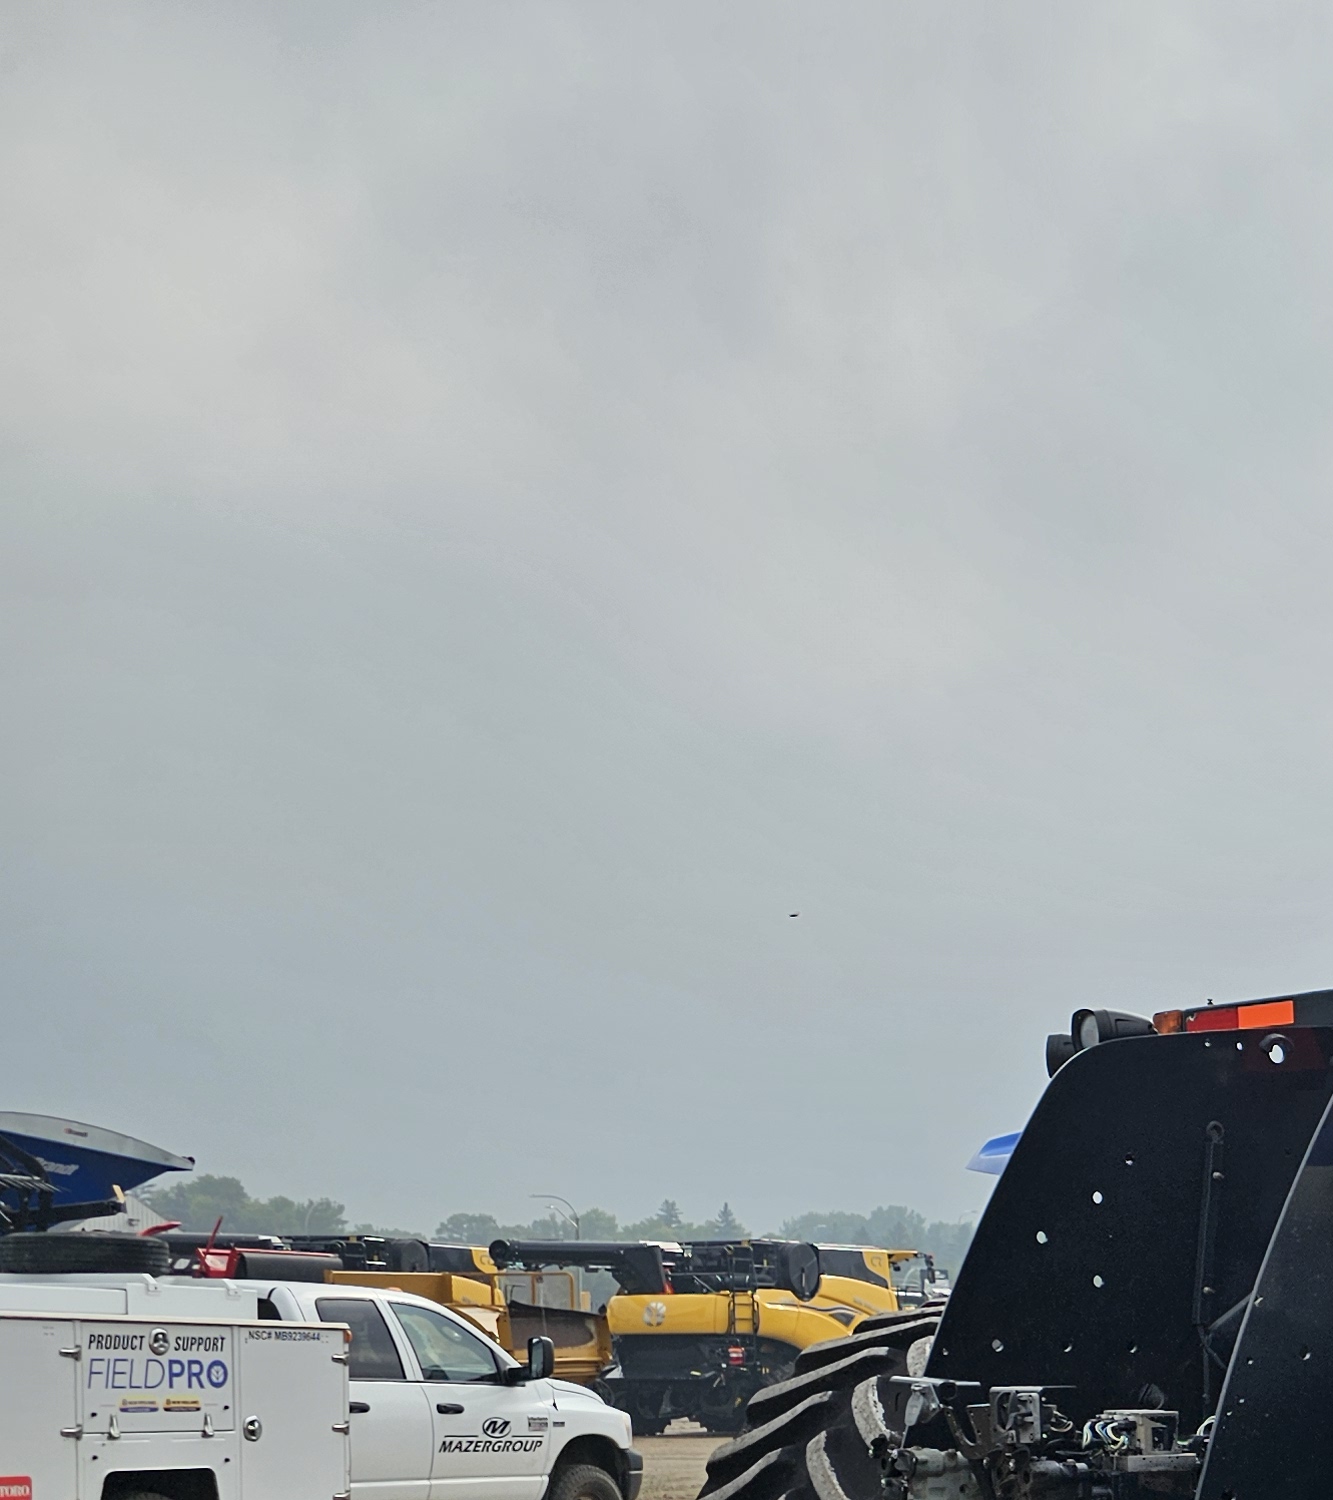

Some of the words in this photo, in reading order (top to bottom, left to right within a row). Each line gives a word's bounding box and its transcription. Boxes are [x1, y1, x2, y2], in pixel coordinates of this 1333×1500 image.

[88, 1333, 146, 1350] PRODUCT
[174, 1336, 226, 1352] SUPPORT
[248, 1330, 272, 1341] NSC#
[87, 1358, 229, 1389] FIELDPRO
[438, 1440, 543, 1453] MAZERGROUP
